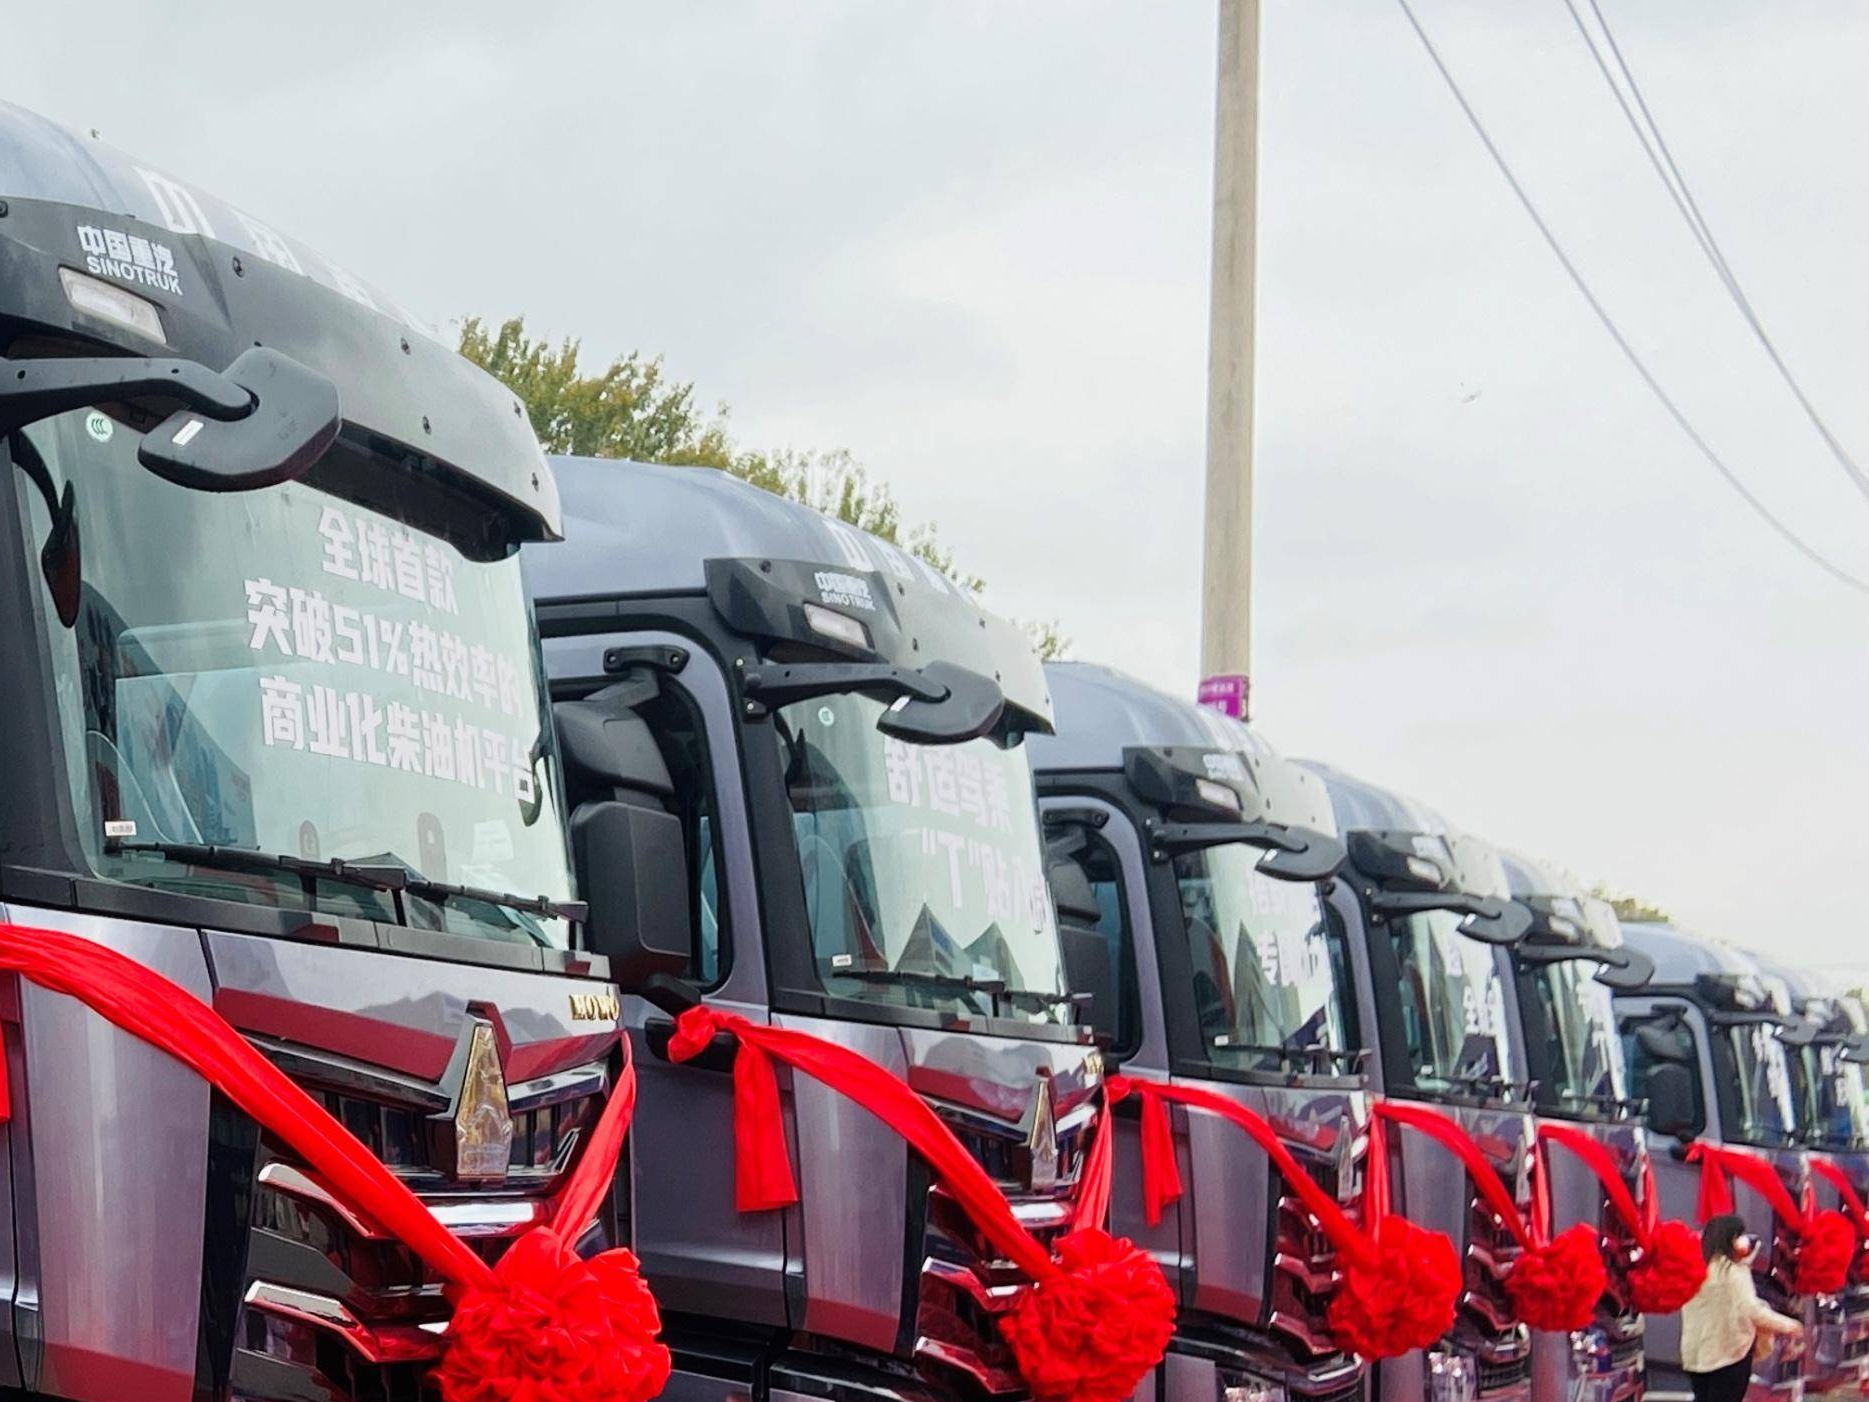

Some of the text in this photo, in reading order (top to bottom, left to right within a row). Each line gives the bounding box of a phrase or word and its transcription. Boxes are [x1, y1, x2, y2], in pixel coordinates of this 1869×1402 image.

[77, 225, 178, 277] 中国重汽
[86, 255, 183, 296] SINOTRUK
[317, 505, 459, 616] 全球首款
[243, 576, 523, 721] 突破51%热效率的
[259, 674, 536, 805] 商业化柴油机平台
